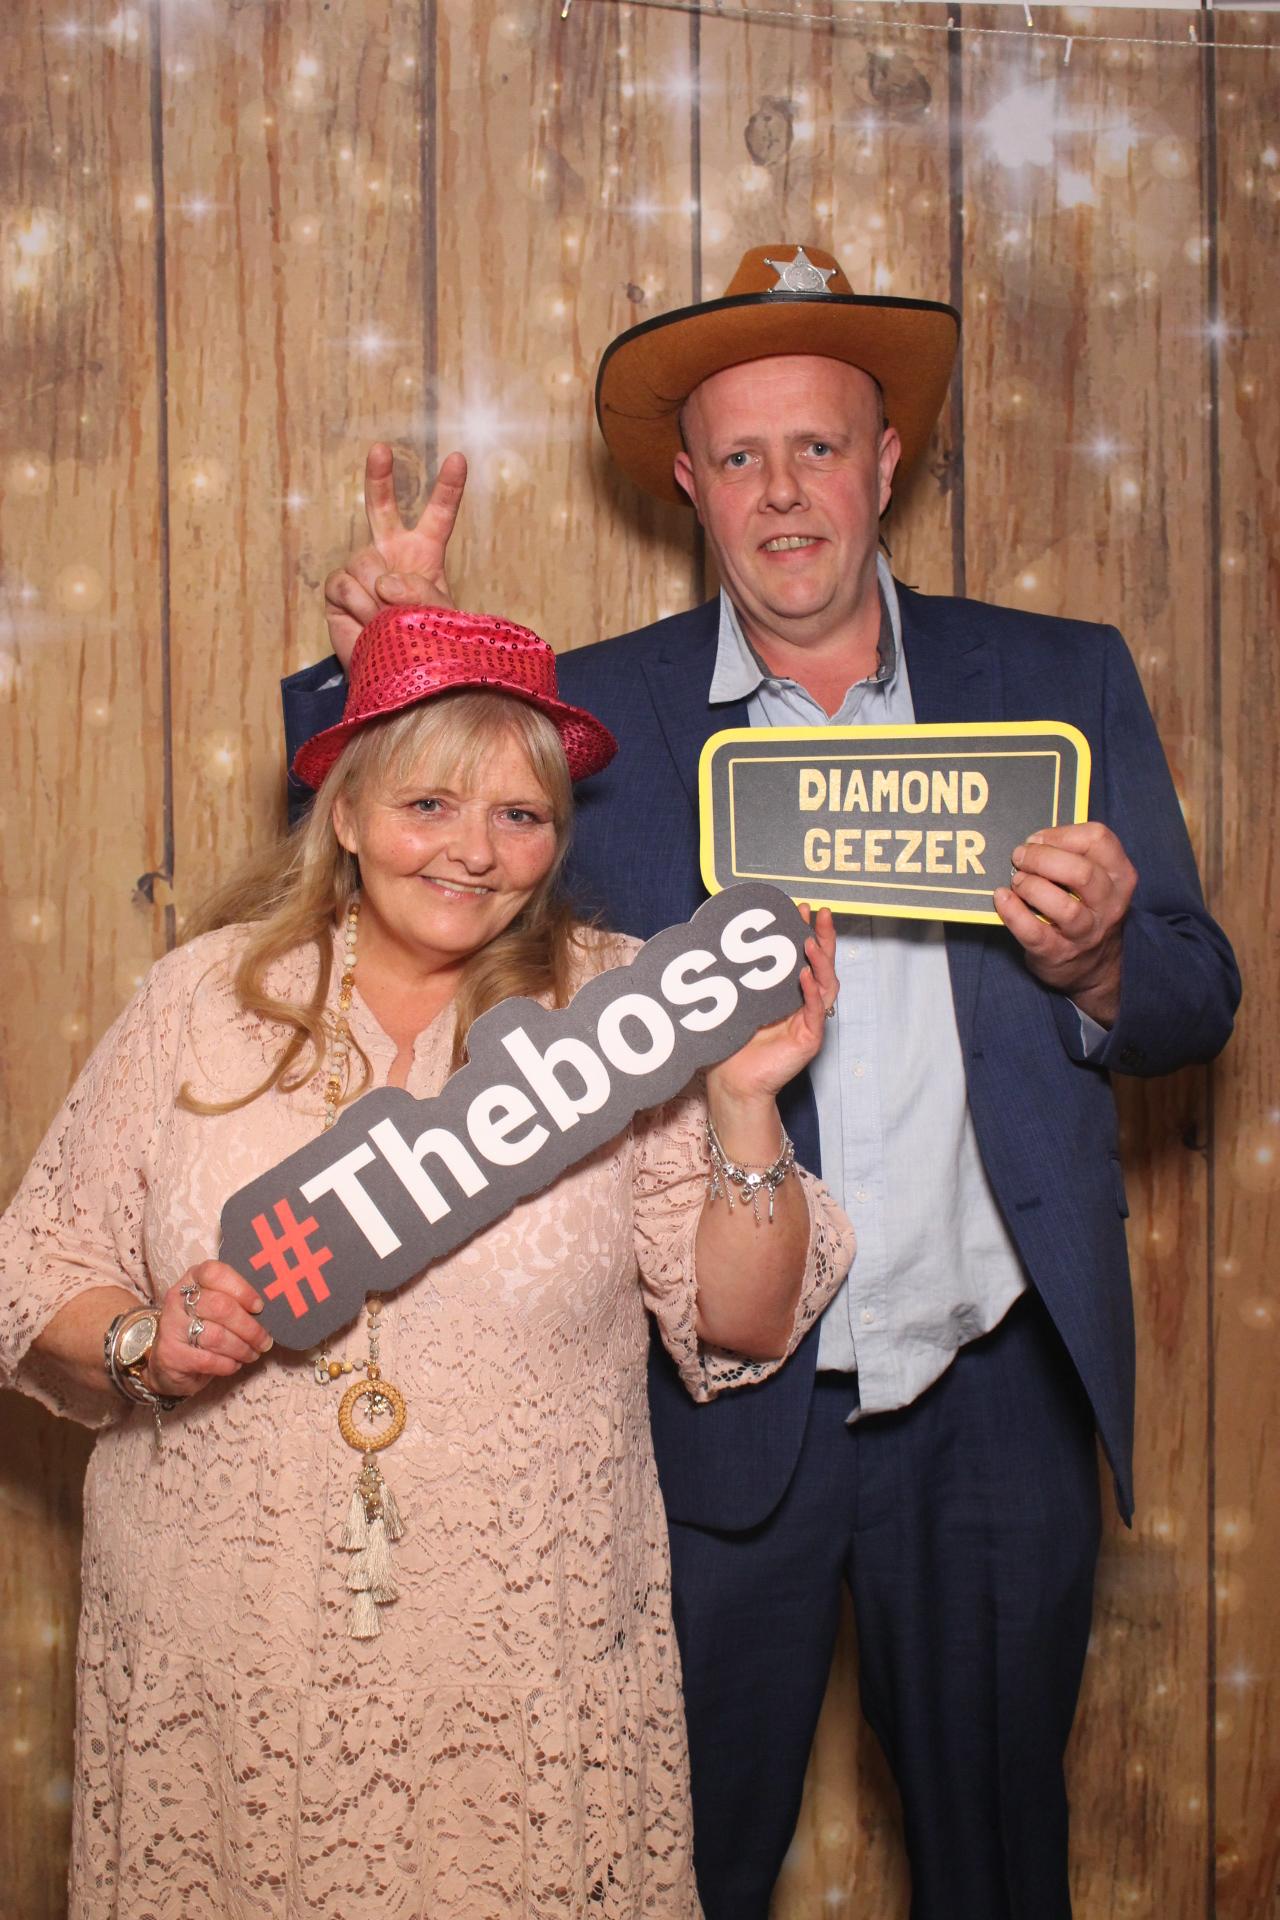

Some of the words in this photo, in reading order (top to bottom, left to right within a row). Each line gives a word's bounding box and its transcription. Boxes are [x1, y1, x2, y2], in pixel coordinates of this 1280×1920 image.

[800, 768, 989, 814] DIAMOND
[804, 828, 986, 874] GEEZER
[249, 908, 797, 1318] #Theboss
